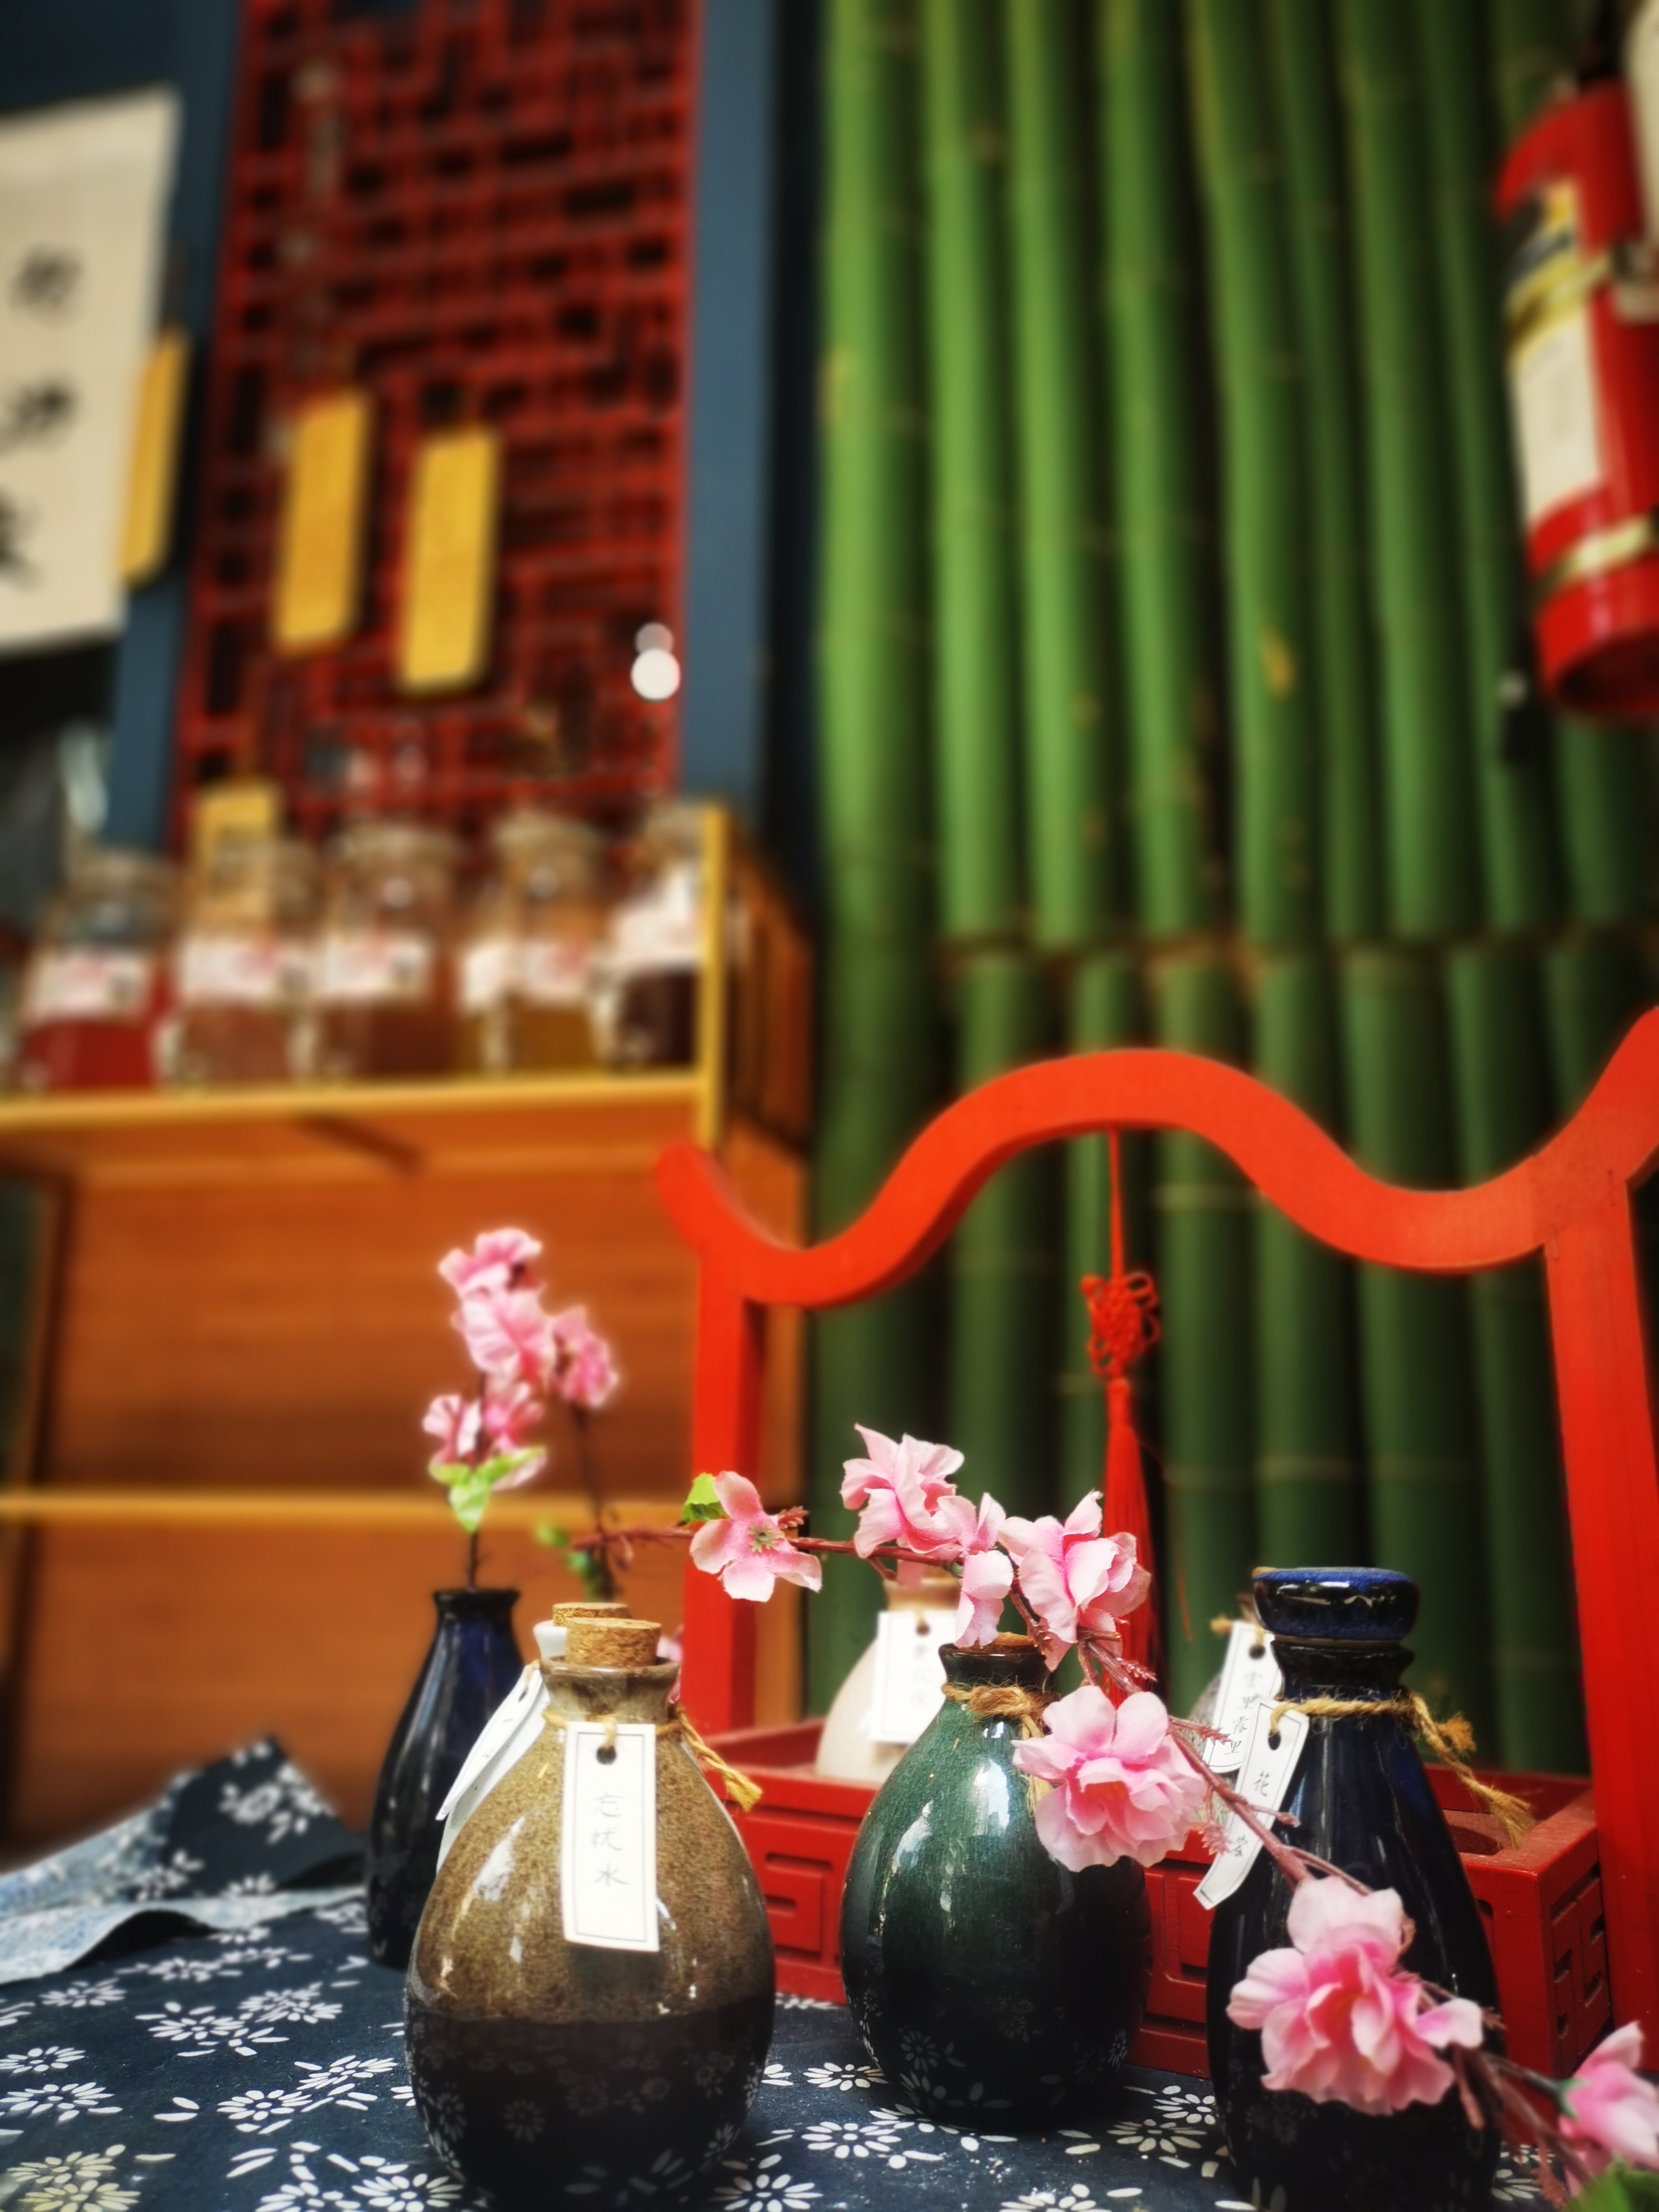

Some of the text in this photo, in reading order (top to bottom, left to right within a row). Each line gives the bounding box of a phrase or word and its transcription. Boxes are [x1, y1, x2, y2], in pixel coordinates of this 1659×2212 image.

[591, 1791, 631, 1887] 忘忧水
[1230, 1770, 1270, 1857] 花容
